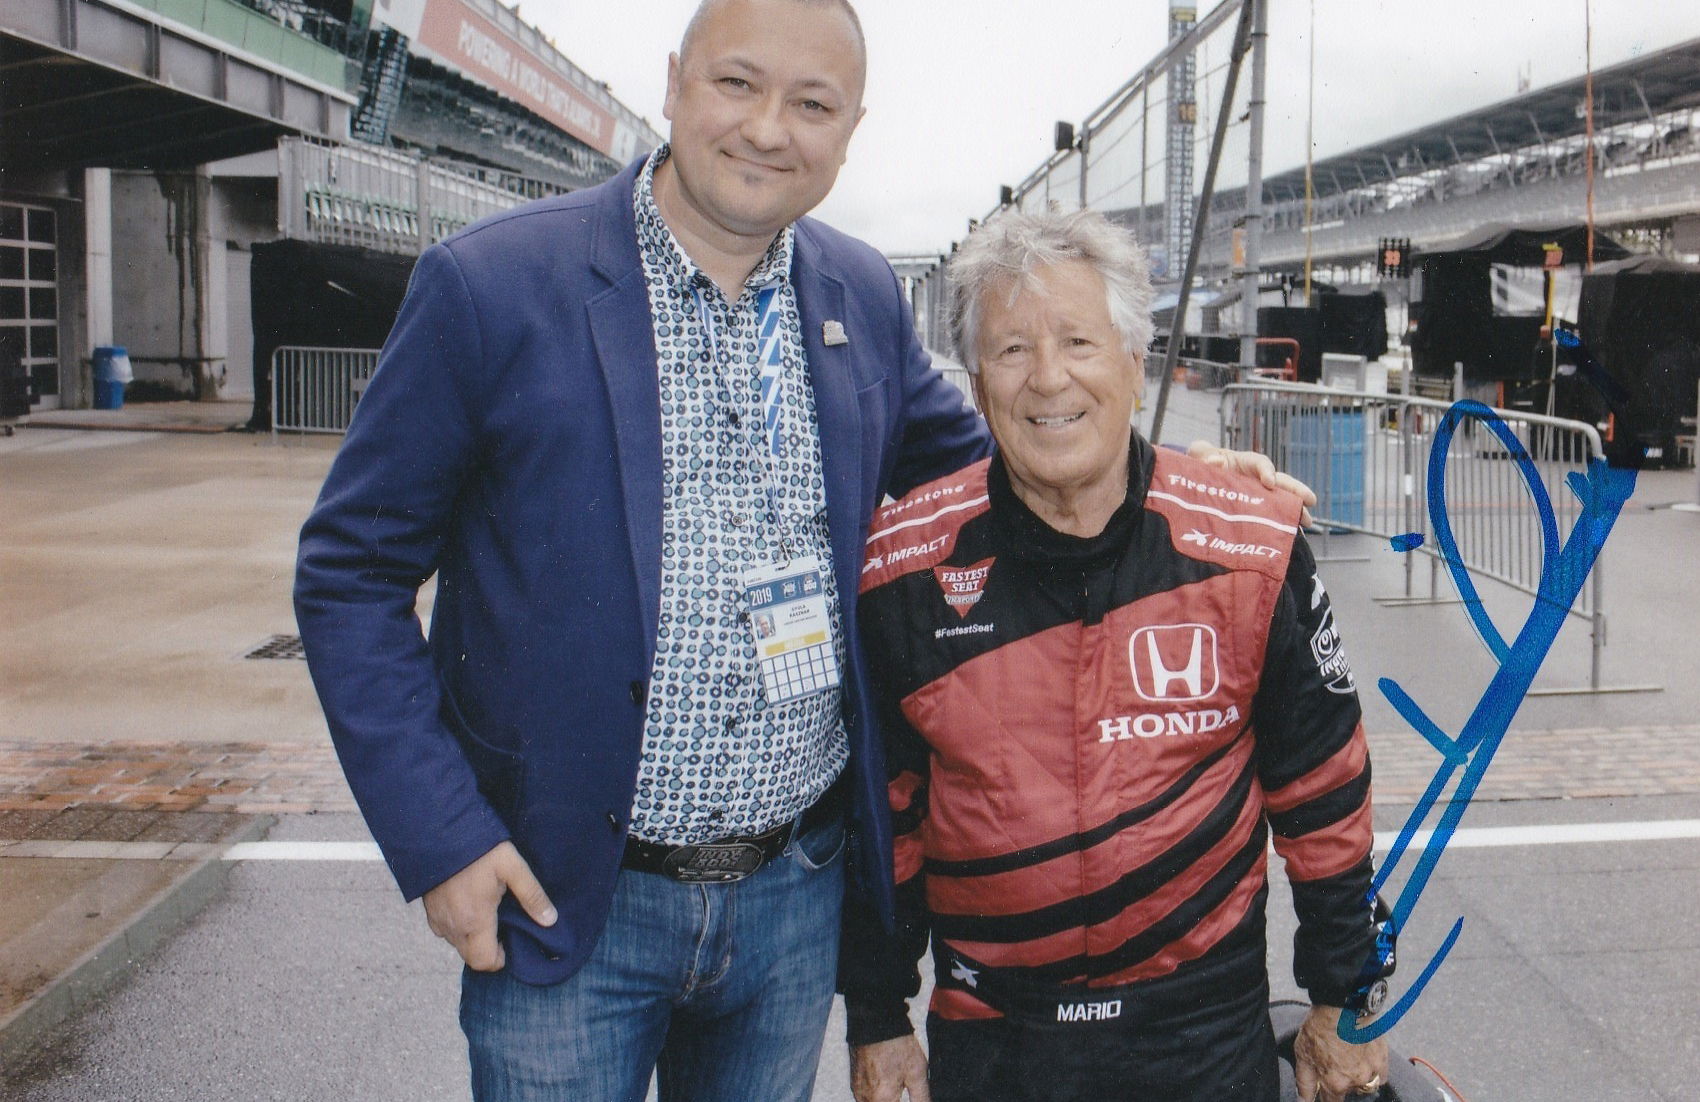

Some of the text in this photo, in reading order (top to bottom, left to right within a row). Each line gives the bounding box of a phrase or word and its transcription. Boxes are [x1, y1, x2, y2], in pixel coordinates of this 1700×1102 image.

[1168, 474, 1265, 505] Firestone
[881, 483, 967, 520] Firestone
[887, 534, 950, 565] IMPACT
[1209, 538, 1282, 559] IMPACT
[941, 566, 990, 583] FASTEST
[951, 579, 980, 593] SEAT
[750, 587, 774, 607] 2019
[935, 622, 994, 639] #FastestSeat
[1098, 704, 1241, 744] HONDA
[1056, 1000, 1122, 1022] MARIO
